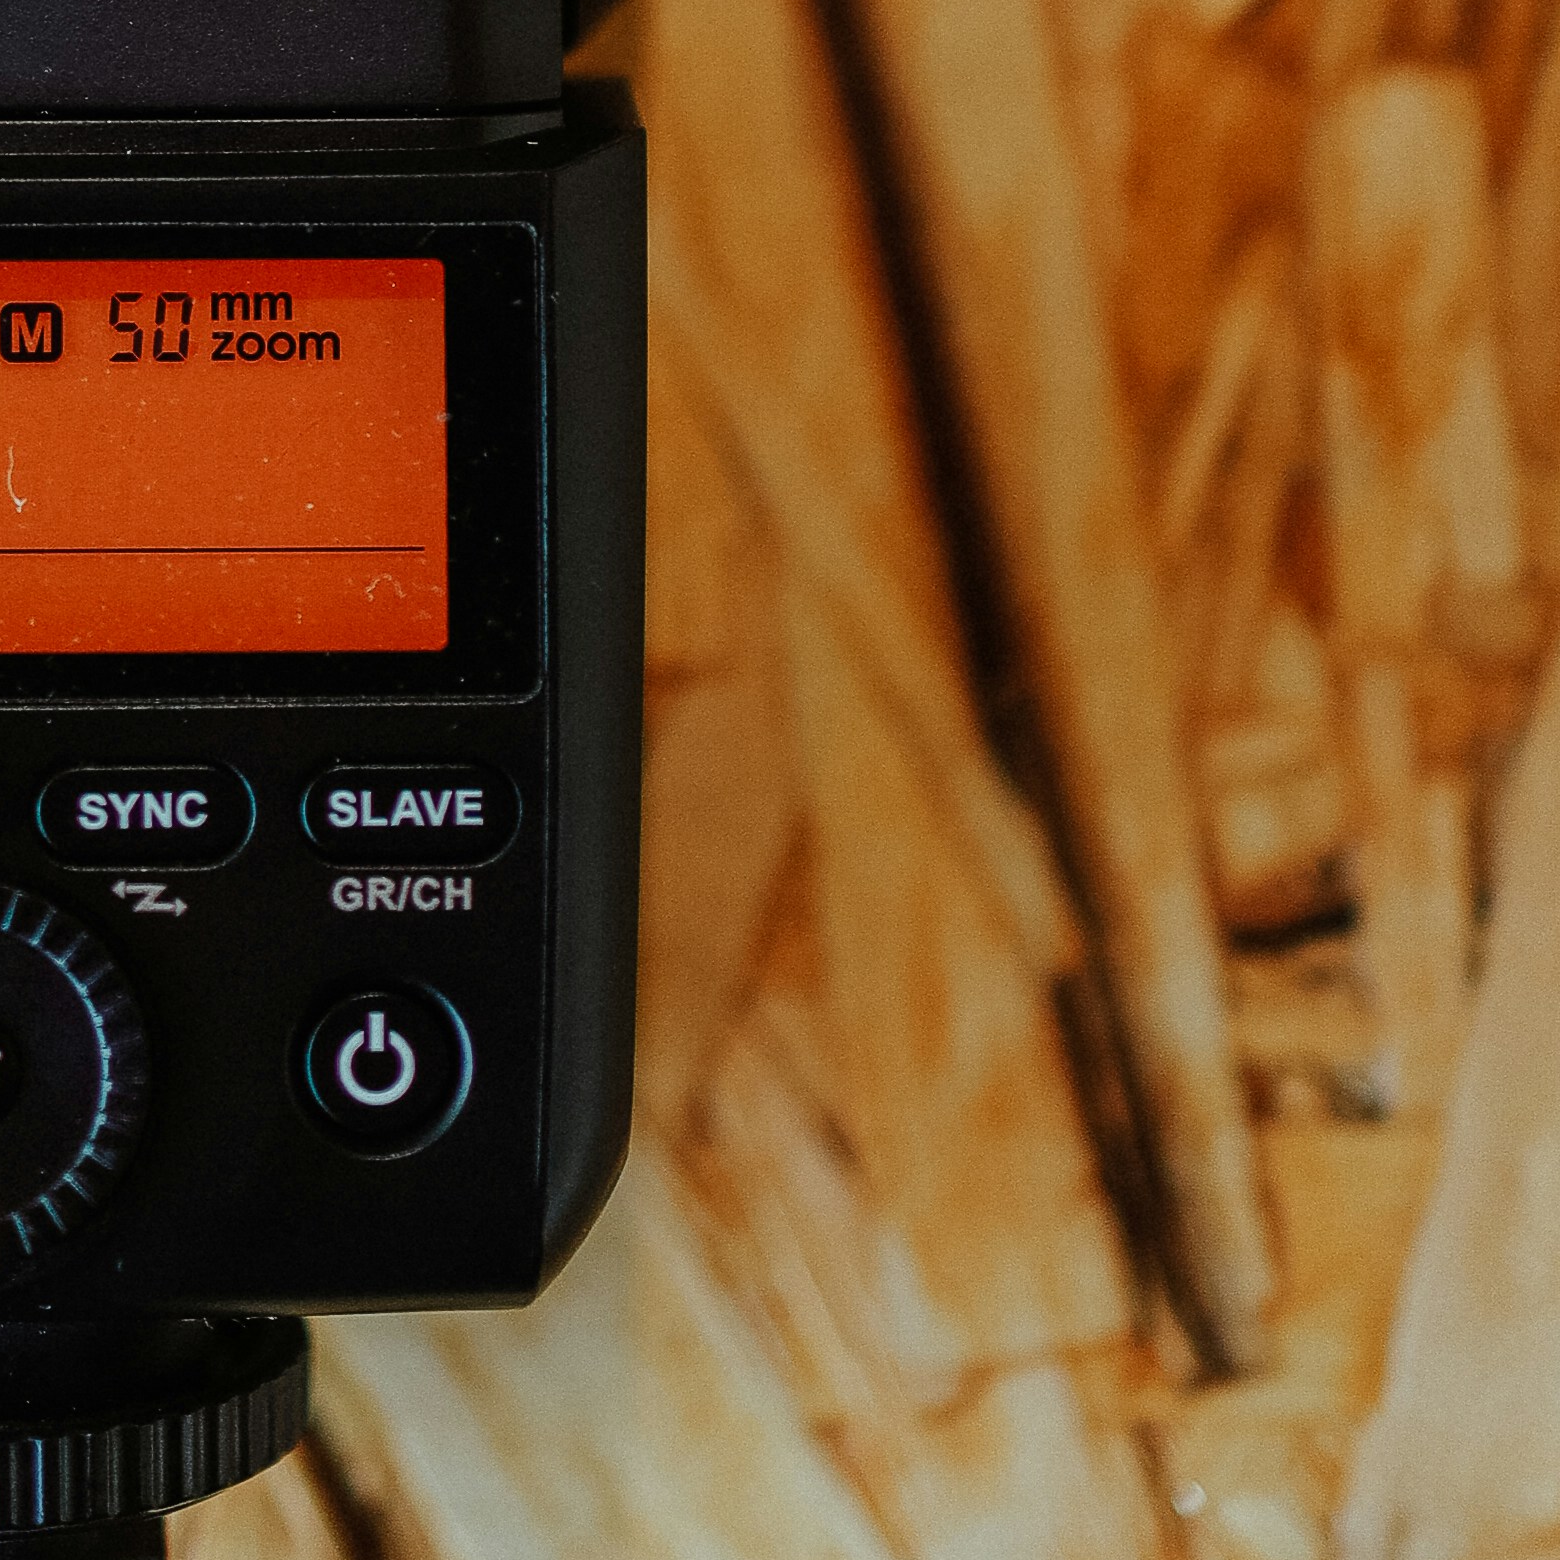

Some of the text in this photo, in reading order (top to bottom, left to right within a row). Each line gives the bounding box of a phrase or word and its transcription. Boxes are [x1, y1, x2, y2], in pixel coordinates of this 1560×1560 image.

[10, 311, 53, 354] M
[108, 291, 293, 363] 50 mm
[210, 330, 341, 362] zoom
[76, 791, 209, 830] SYNC
[327, 789, 485, 828] SLAVE
[331, 877, 474, 912] GR/CH
